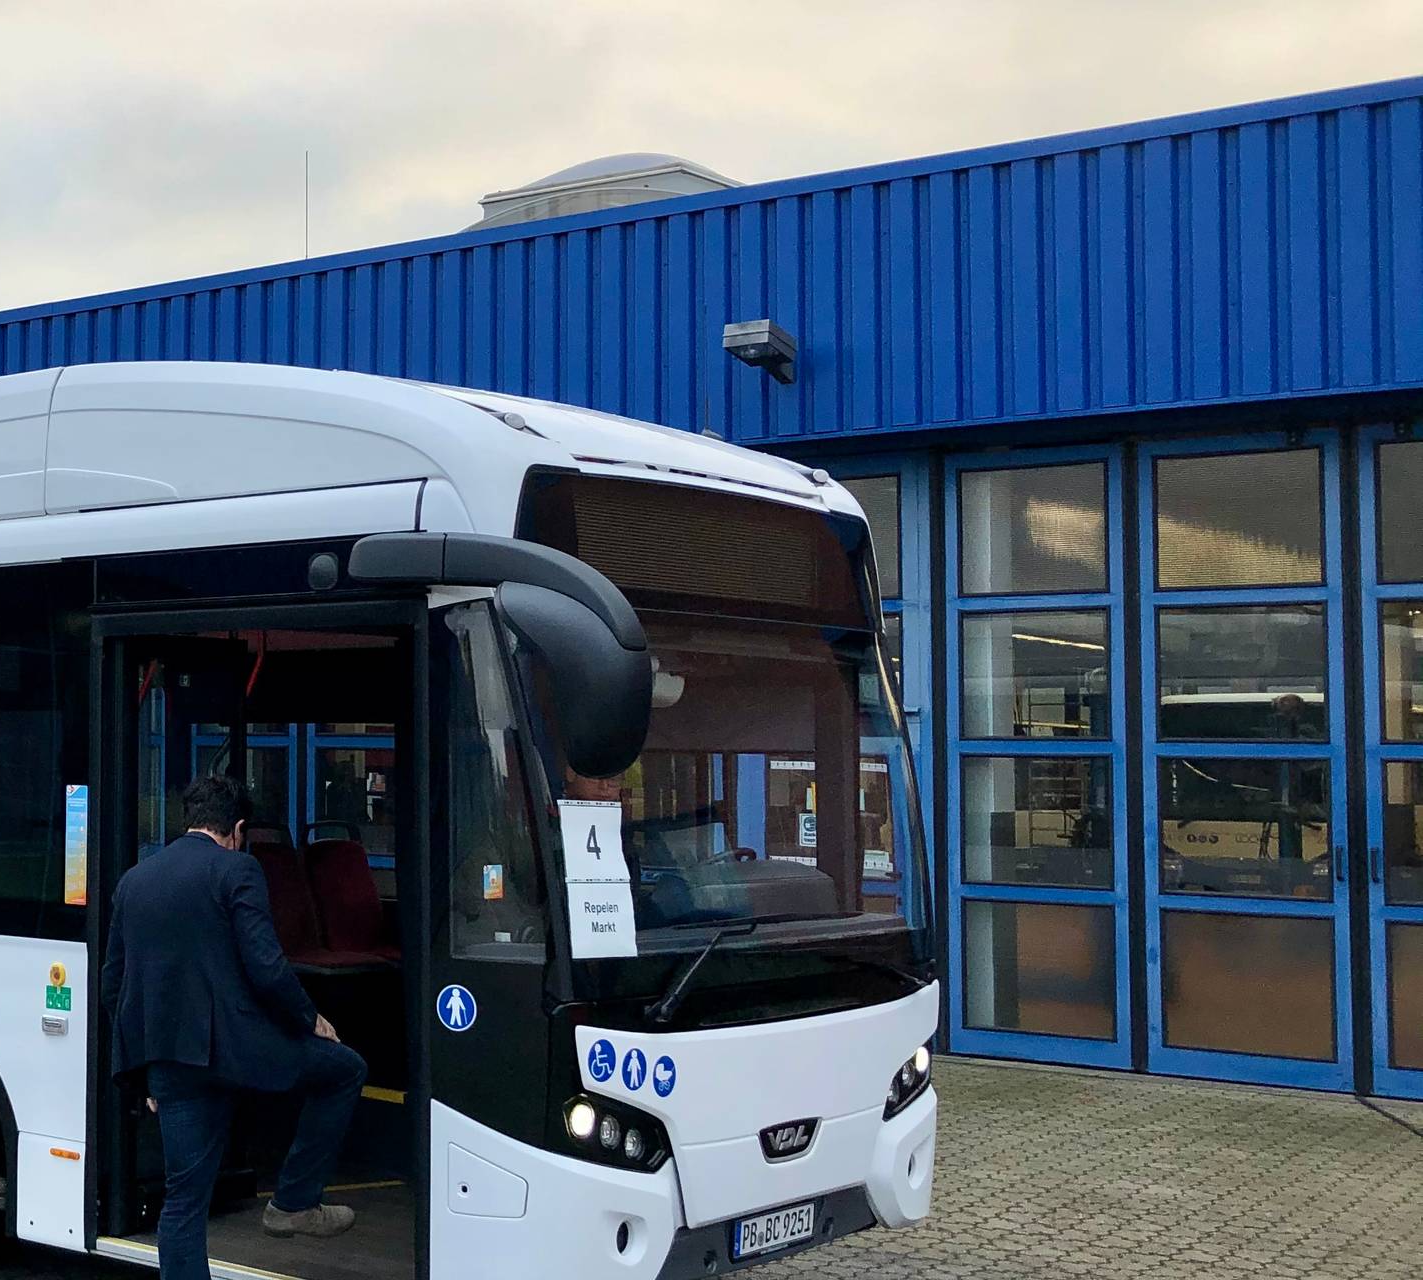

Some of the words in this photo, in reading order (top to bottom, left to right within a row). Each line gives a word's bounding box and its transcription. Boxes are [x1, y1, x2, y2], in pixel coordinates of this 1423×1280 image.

[586, 824, 602, 860] 4
[584, 902, 619, 916] Repelen
[591, 921, 617, 933] Markt
[767, 1125, 809, 1151] VDL
[742, 1222, 758, 1250] PB
[765, 1216, 781, 1243] BC
[783, 1207, 811, 1239] 9251
